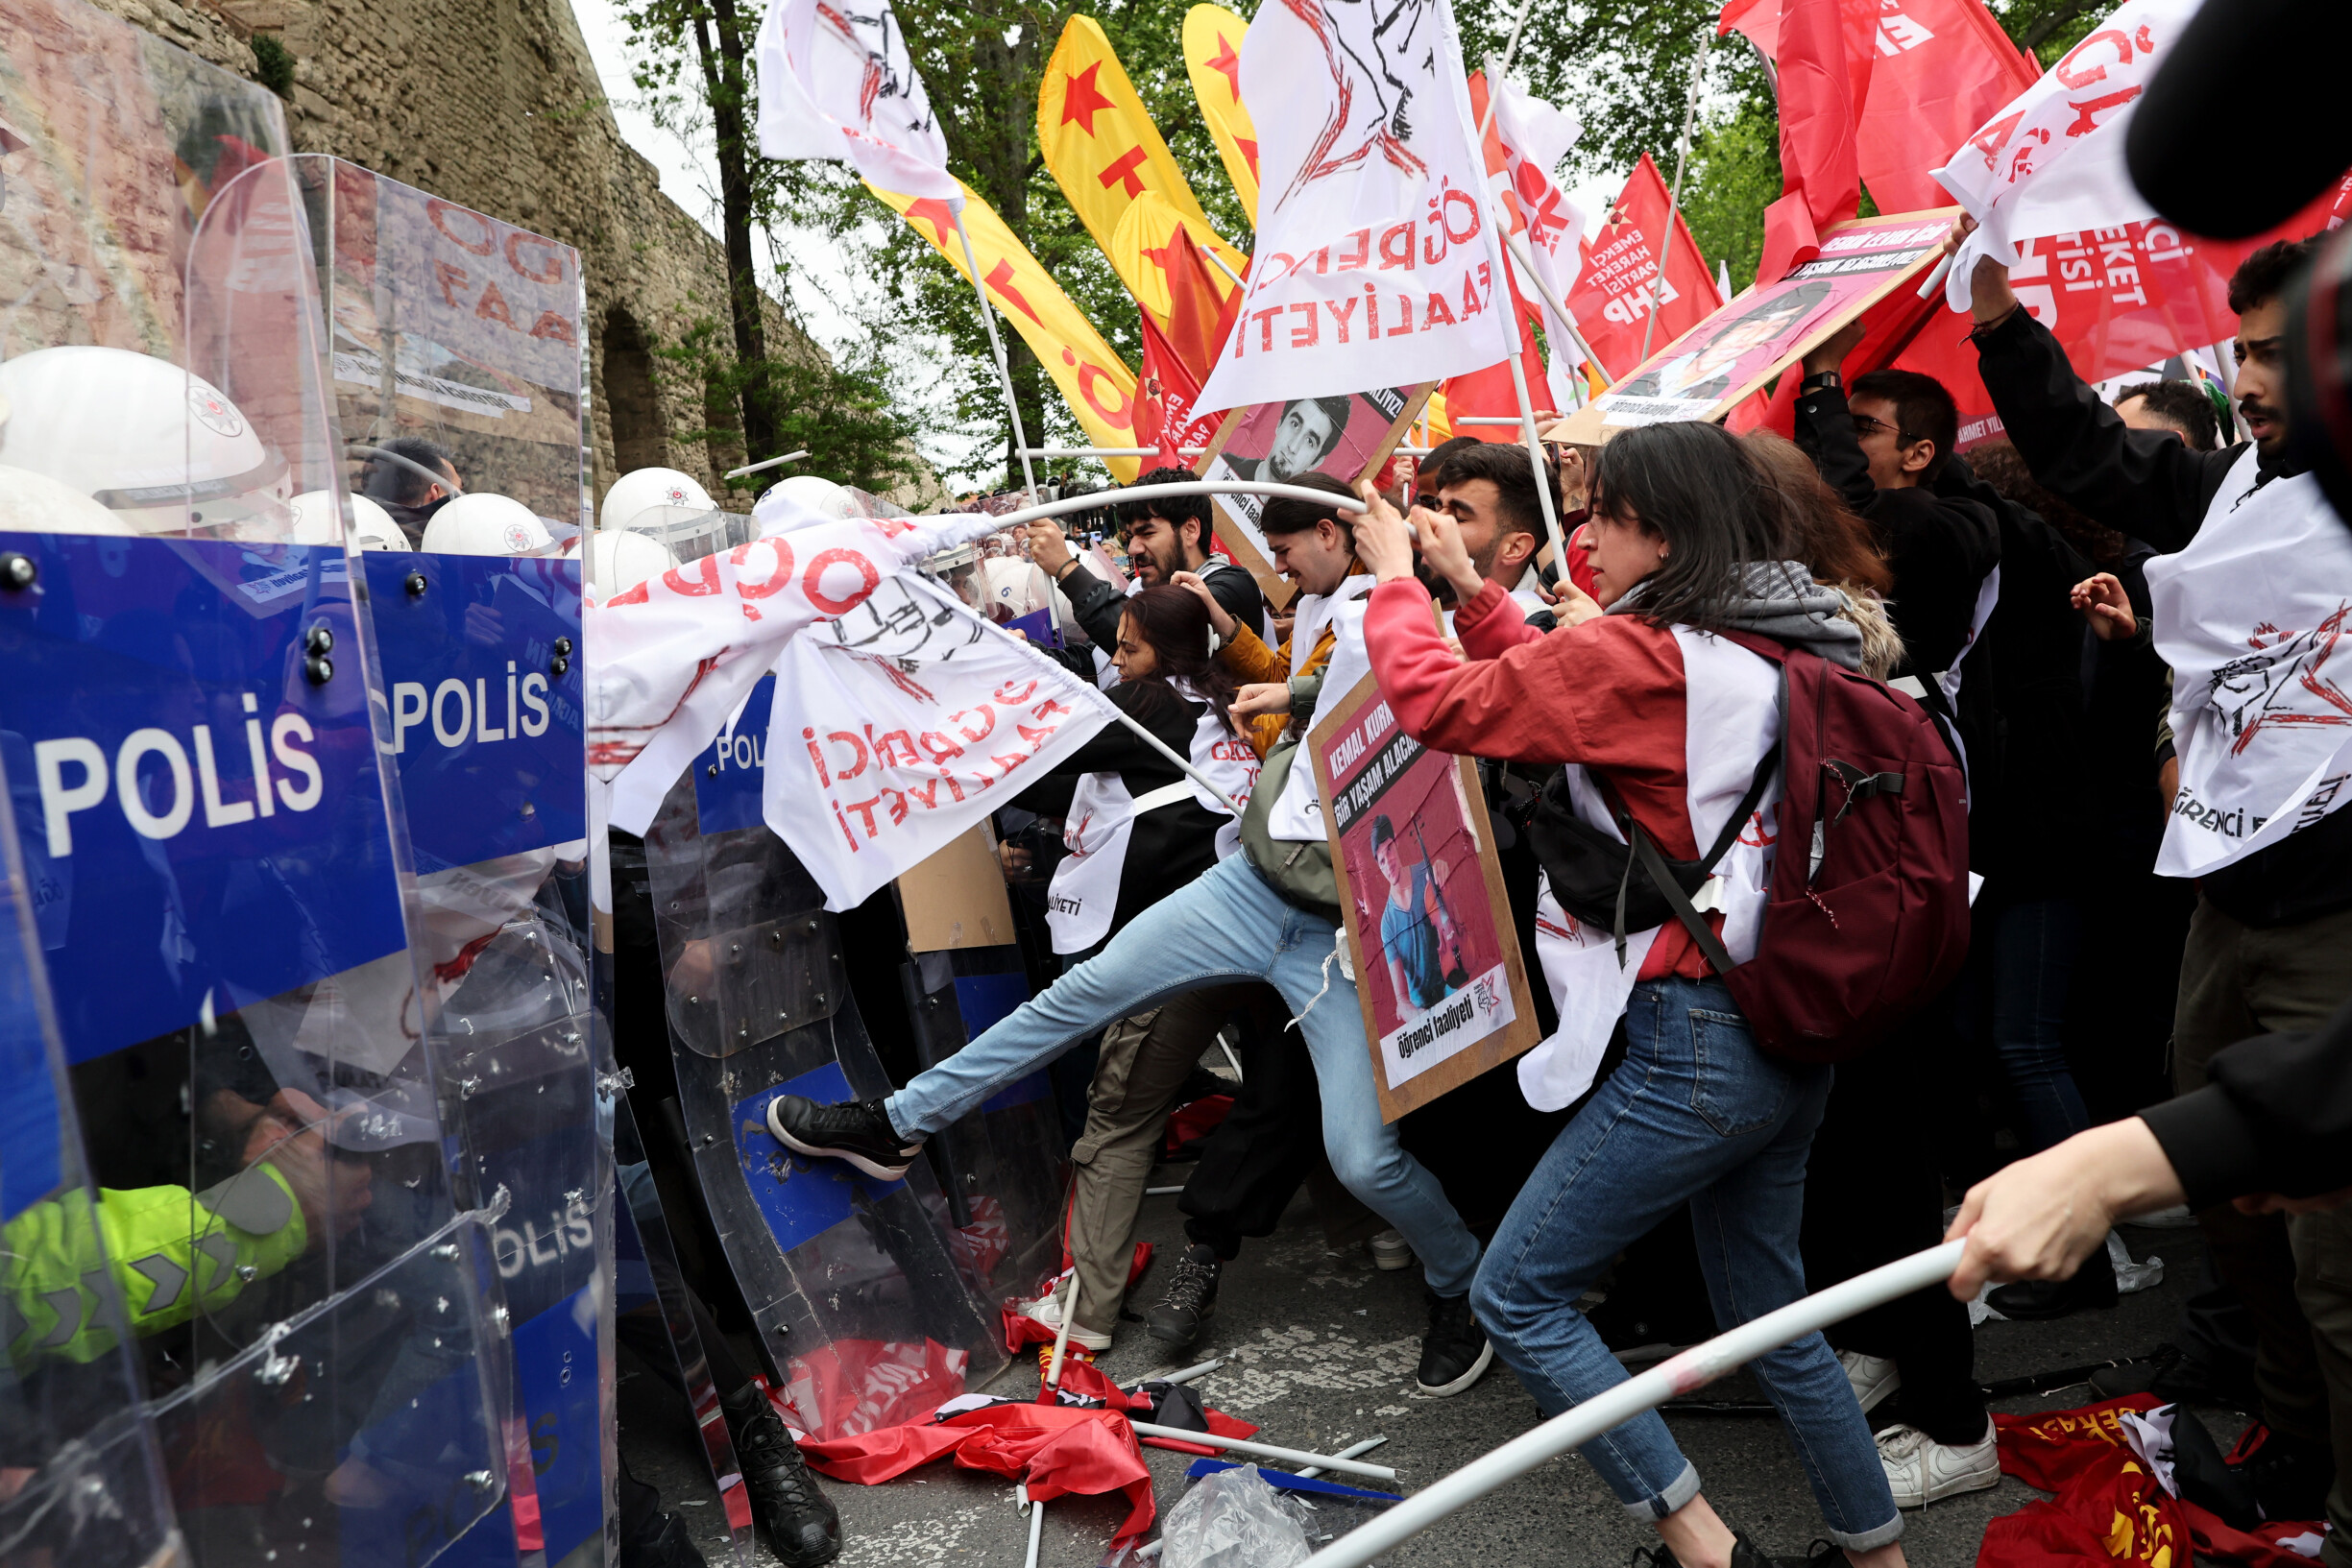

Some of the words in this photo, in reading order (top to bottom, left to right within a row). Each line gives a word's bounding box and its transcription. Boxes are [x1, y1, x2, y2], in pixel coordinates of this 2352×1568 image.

[1957, 420, 1987, 445] AHMET
[393, 660, 550, 755] POLİS
[35, 692, 324, 858] POLİS
[715, 733, 766, 772] POL
[1329, 726, 1367, 780] KEMAL
[1333, 795, 1352, 829] BİR
[1348, 760, 1385, 808] YAŞAM
[1382, 733, 1421, 780] ALACA
[1396, 1018, 1434, 1060] öğrenci
[1432, 993, 1474, 1039] faaliyeti
[492, 1201, 594, 1279] OLİS
